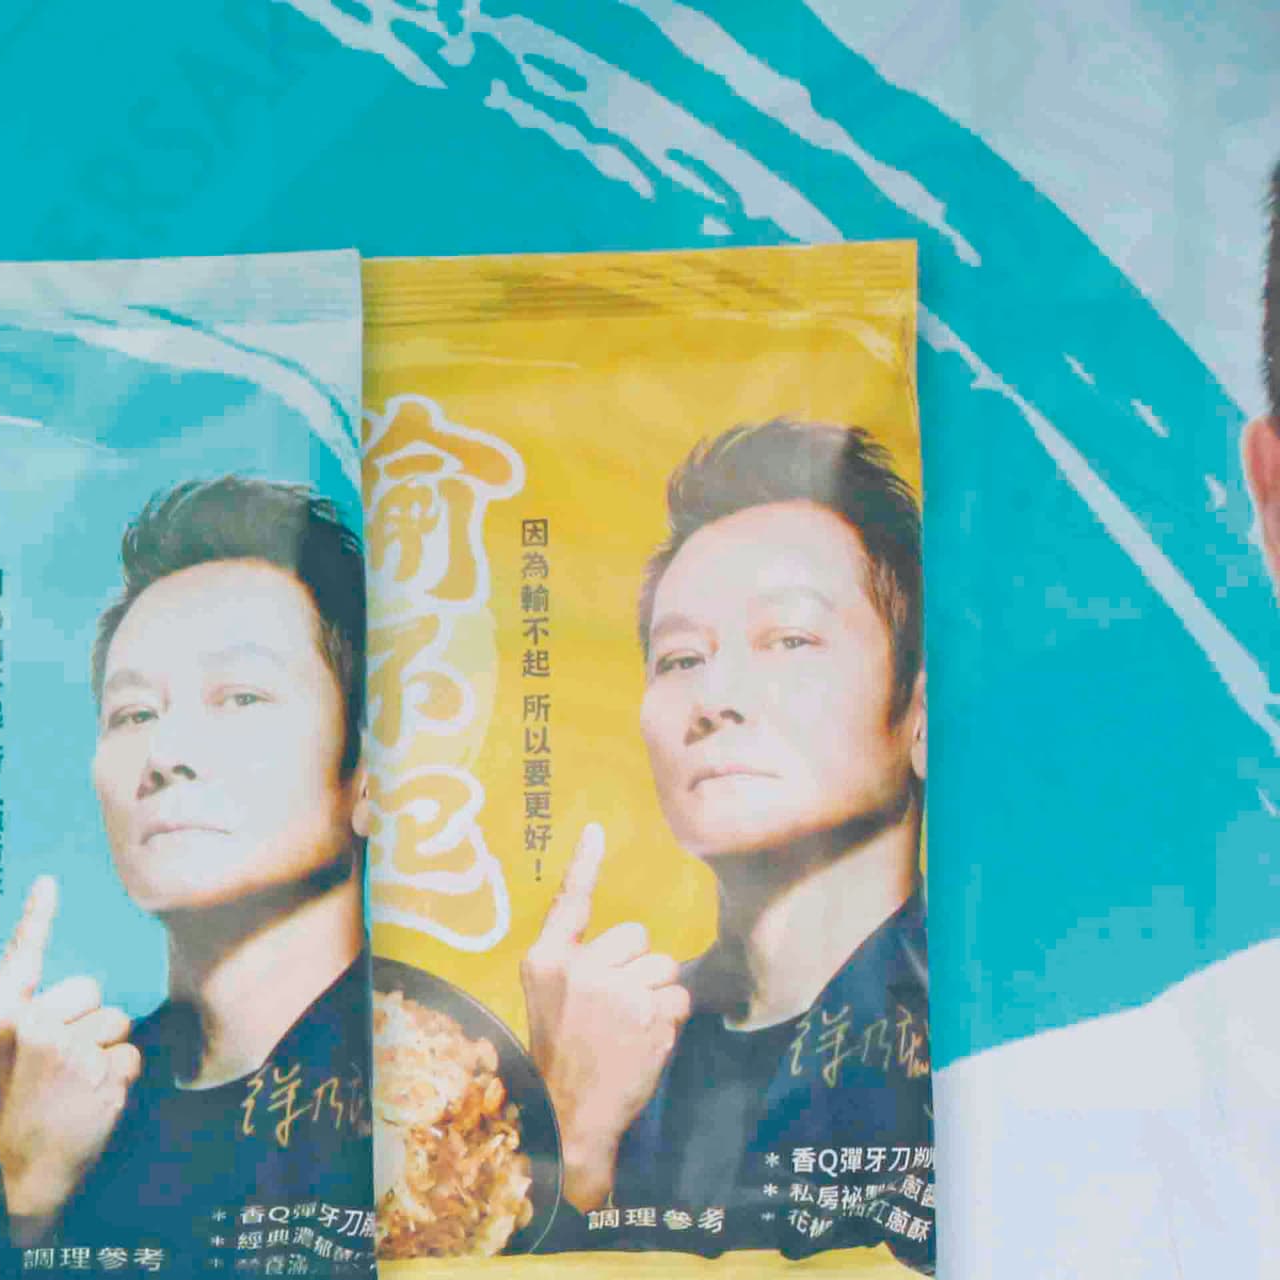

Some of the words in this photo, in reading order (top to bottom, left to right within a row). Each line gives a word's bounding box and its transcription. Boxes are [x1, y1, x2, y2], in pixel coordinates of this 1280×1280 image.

[521, 519, 550, 678] 因為輸不起
[522, 695, 552, 881] 所以要更好!
[23, 1248, 166, 1271] 調理參考
[587, 1208, 726, 1233] 調理參考
